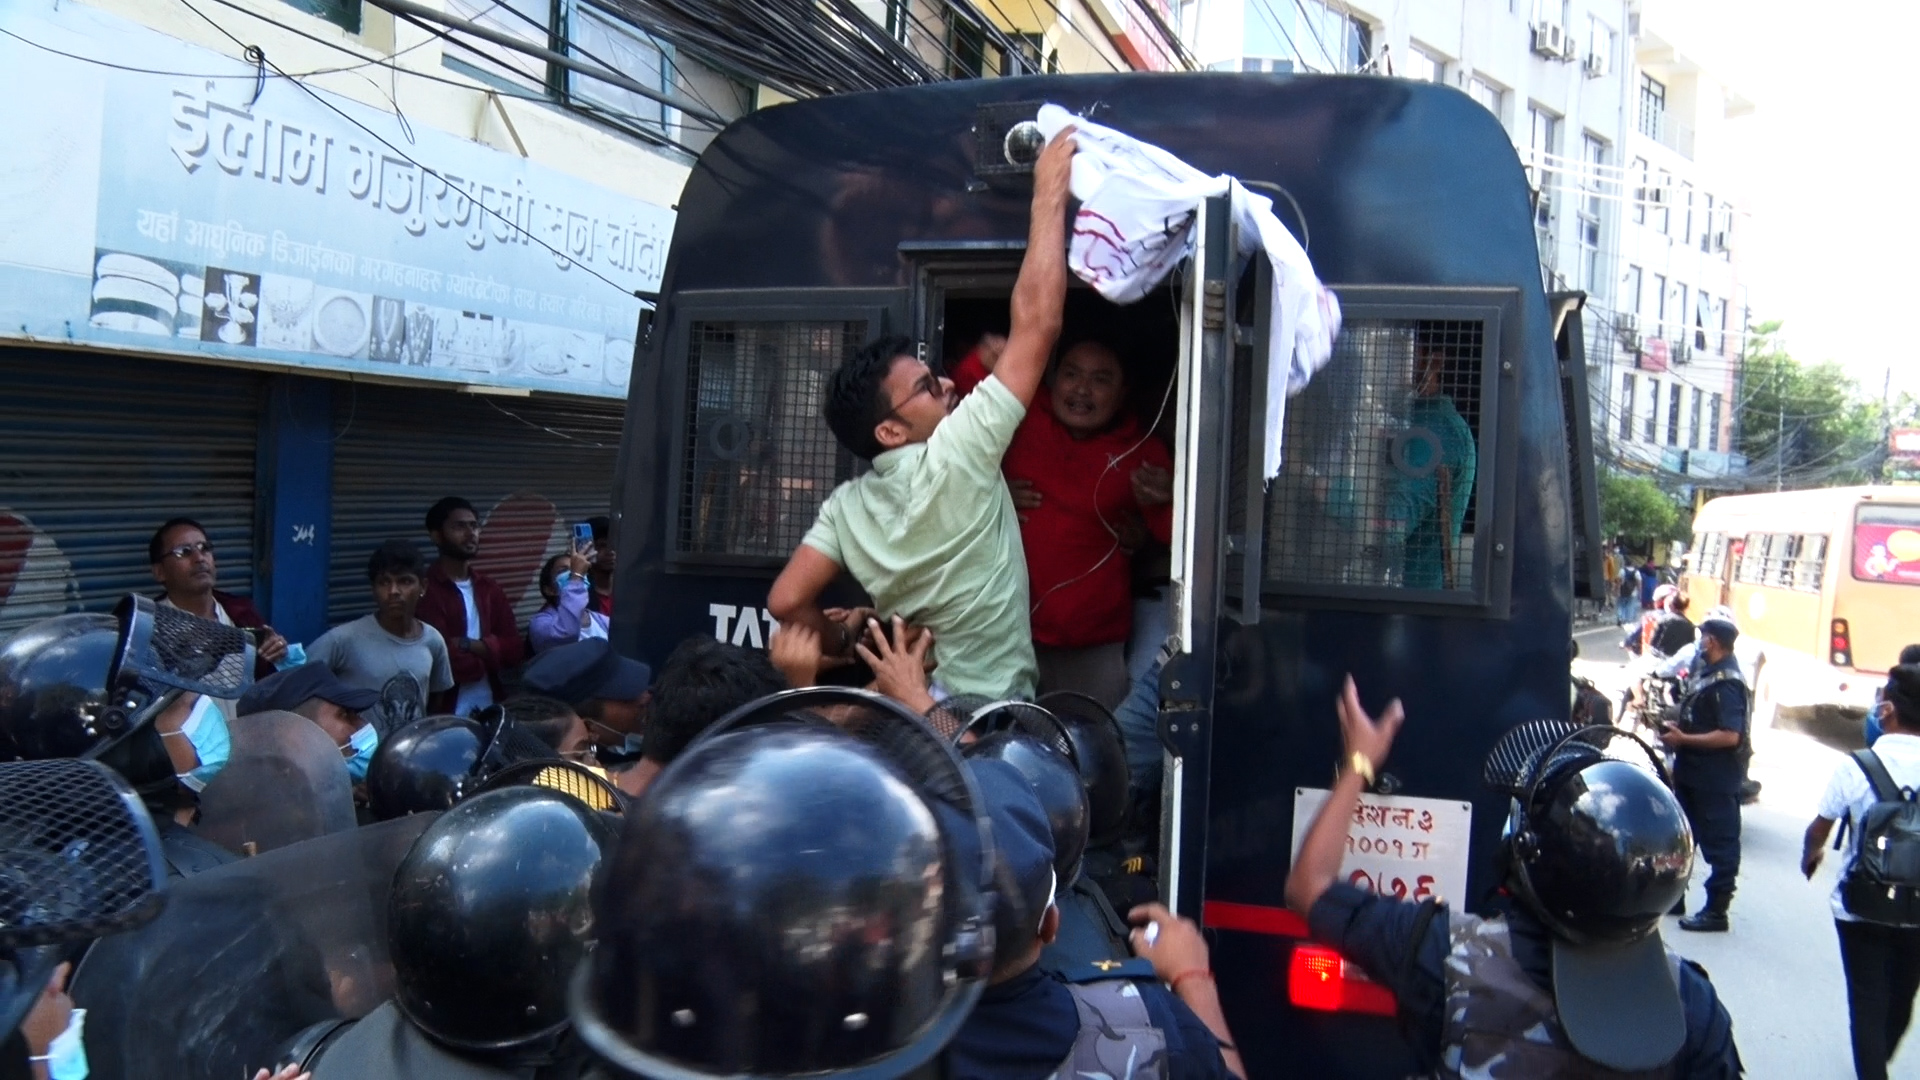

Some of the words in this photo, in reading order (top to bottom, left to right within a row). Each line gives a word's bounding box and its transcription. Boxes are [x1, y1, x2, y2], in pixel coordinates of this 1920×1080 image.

[167, 78, 334, 195] ईलाम
[184, 219, 266, 259] आधुनिक
[271, 229, 356, 277] डिजाईनका
